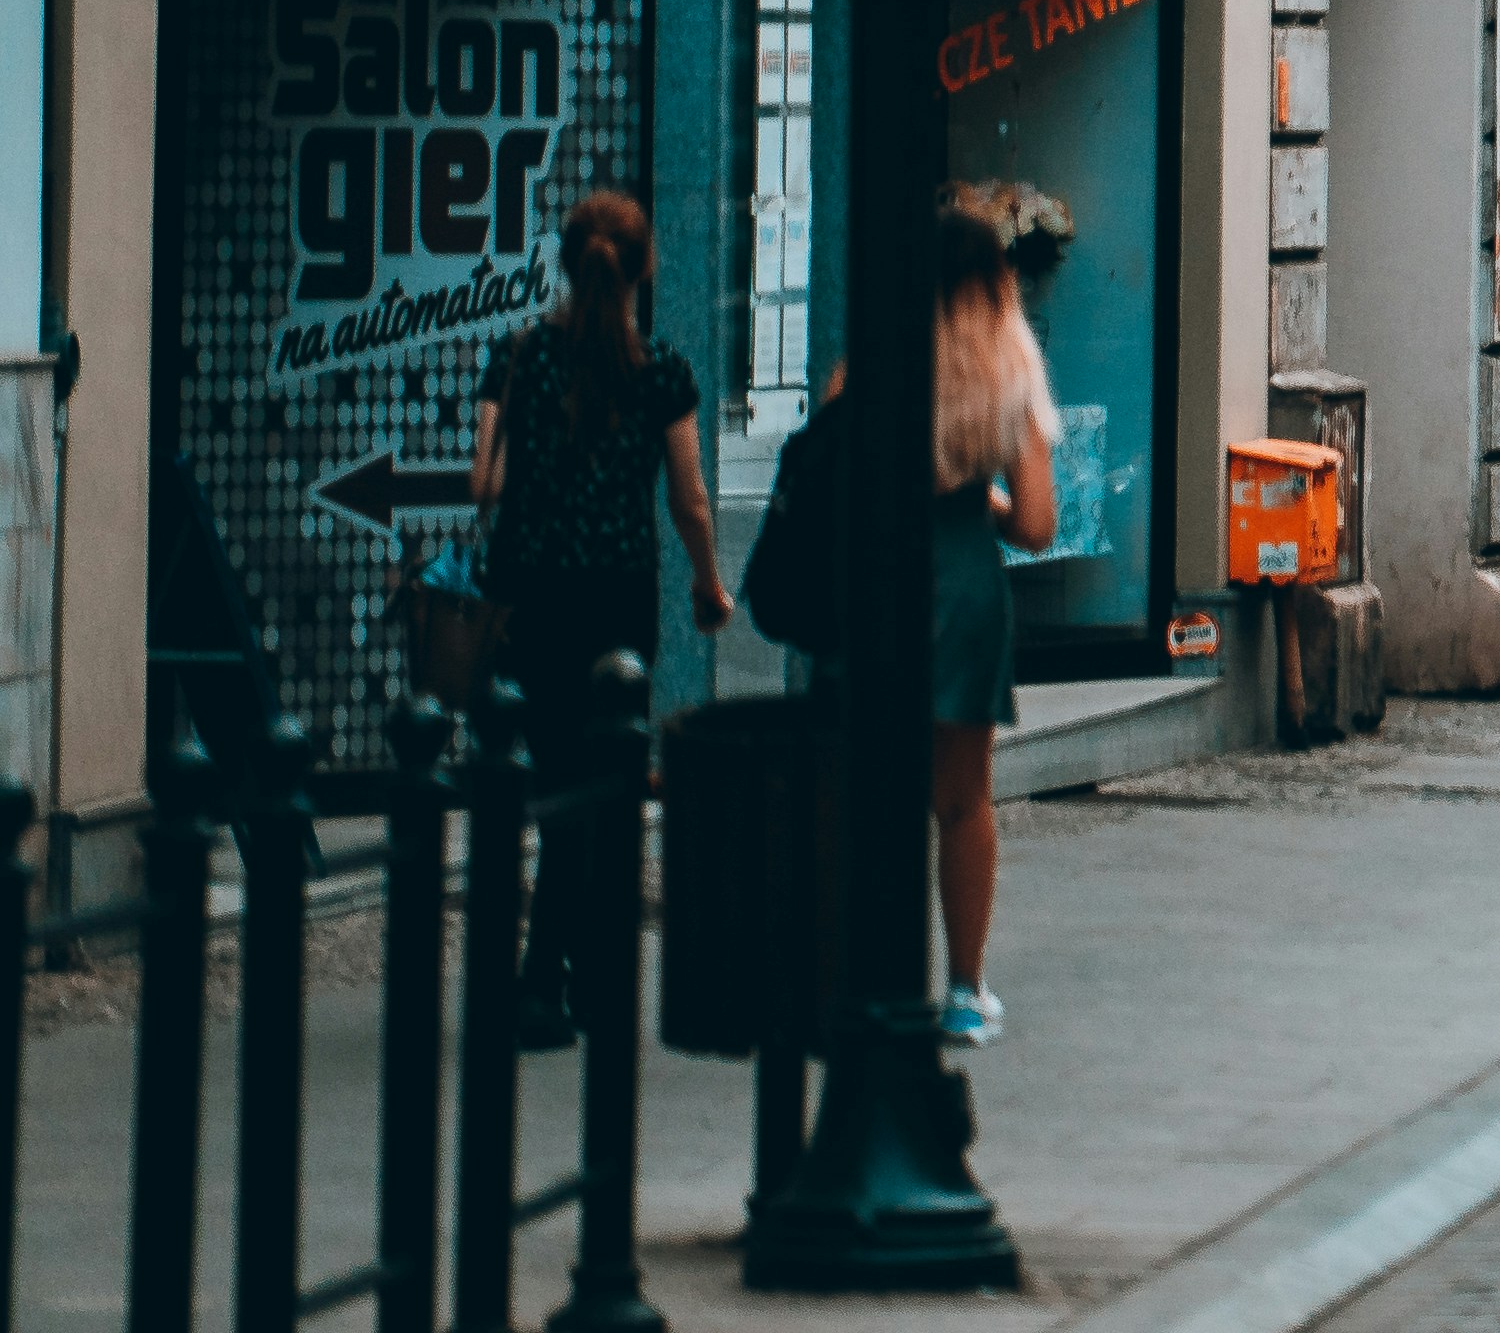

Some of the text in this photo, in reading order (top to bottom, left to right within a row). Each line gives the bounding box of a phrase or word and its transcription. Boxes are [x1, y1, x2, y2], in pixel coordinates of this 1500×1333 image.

[296, 126, 551, 301] gier
[274, 239, 551, 372] na automatach
